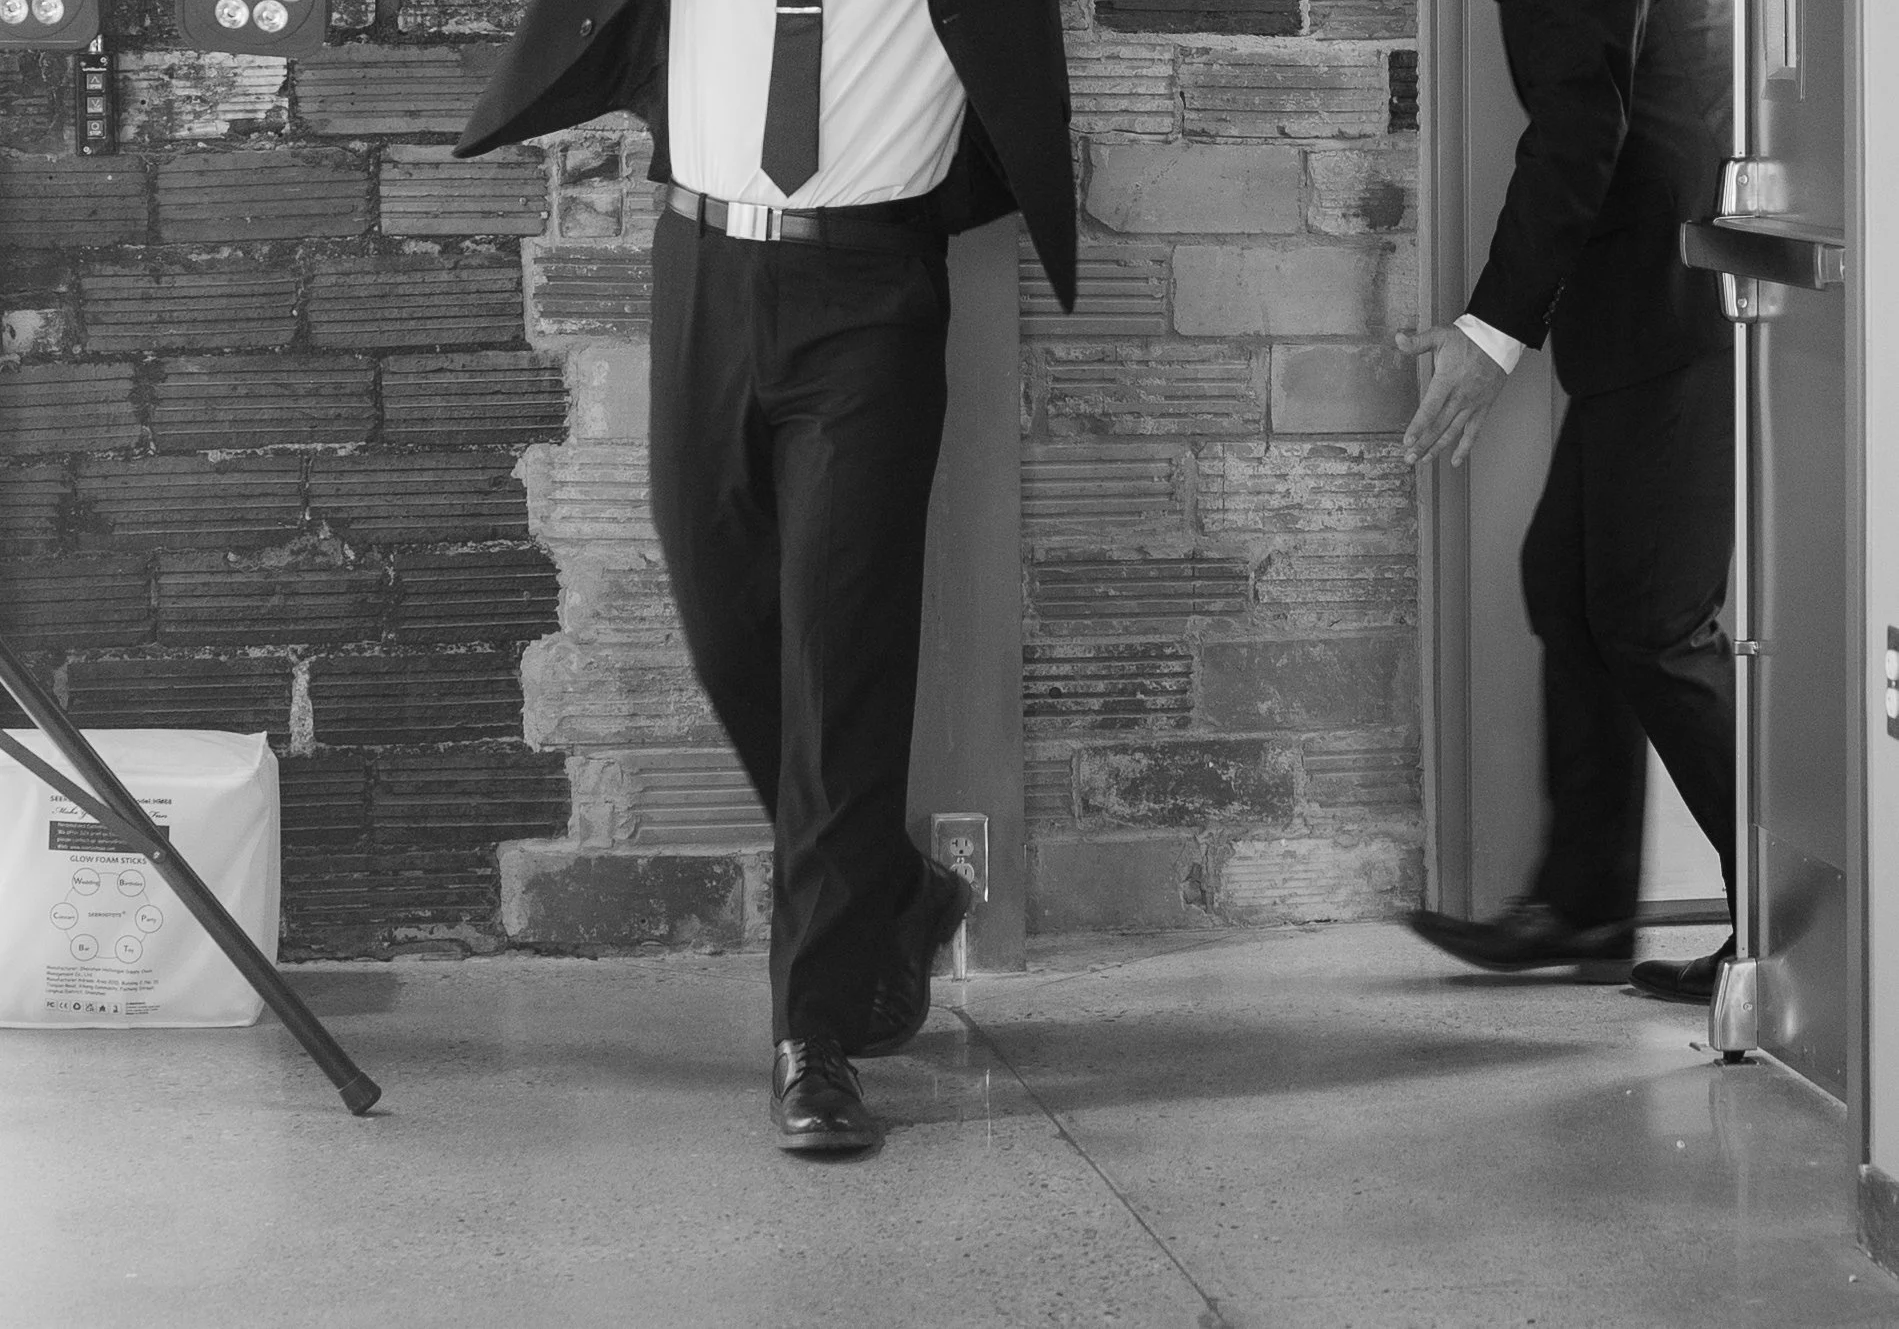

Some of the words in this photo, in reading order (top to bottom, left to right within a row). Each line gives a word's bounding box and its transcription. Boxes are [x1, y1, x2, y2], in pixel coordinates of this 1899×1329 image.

[69, 854, 94, 862] GLOW
[120, 857, 147, 865] STICKS
[73, 877, 101, 887] Wedding
[141, 914, 157, 925] Party
